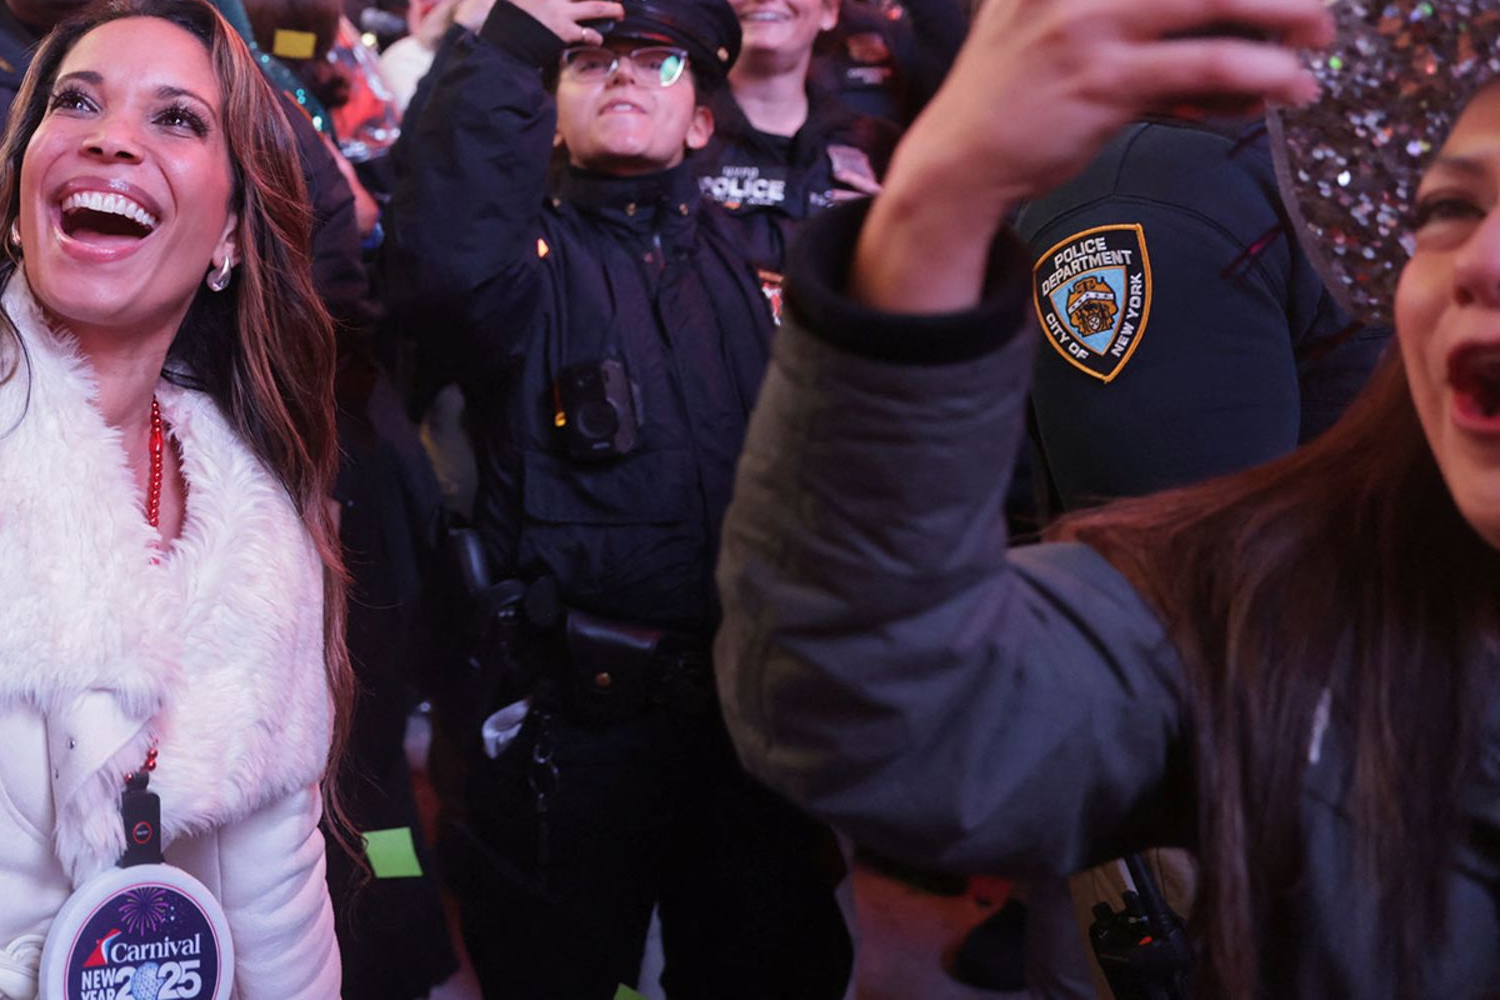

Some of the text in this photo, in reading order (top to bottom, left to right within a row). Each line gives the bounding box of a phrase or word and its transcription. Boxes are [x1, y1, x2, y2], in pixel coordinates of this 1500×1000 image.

[699, 176, 785, 201] POLICE
[1054, 237, 1107, 269] POLICE
[1041, 250, 1133, 297] DEPARTMENT
[1110, 272, 1143, 358] NEW YORK
[1045, 312, 1089, 360] CITY OF
[111, 933, 201, 964] Carnival
[82, 967, 117, 991] NEW
